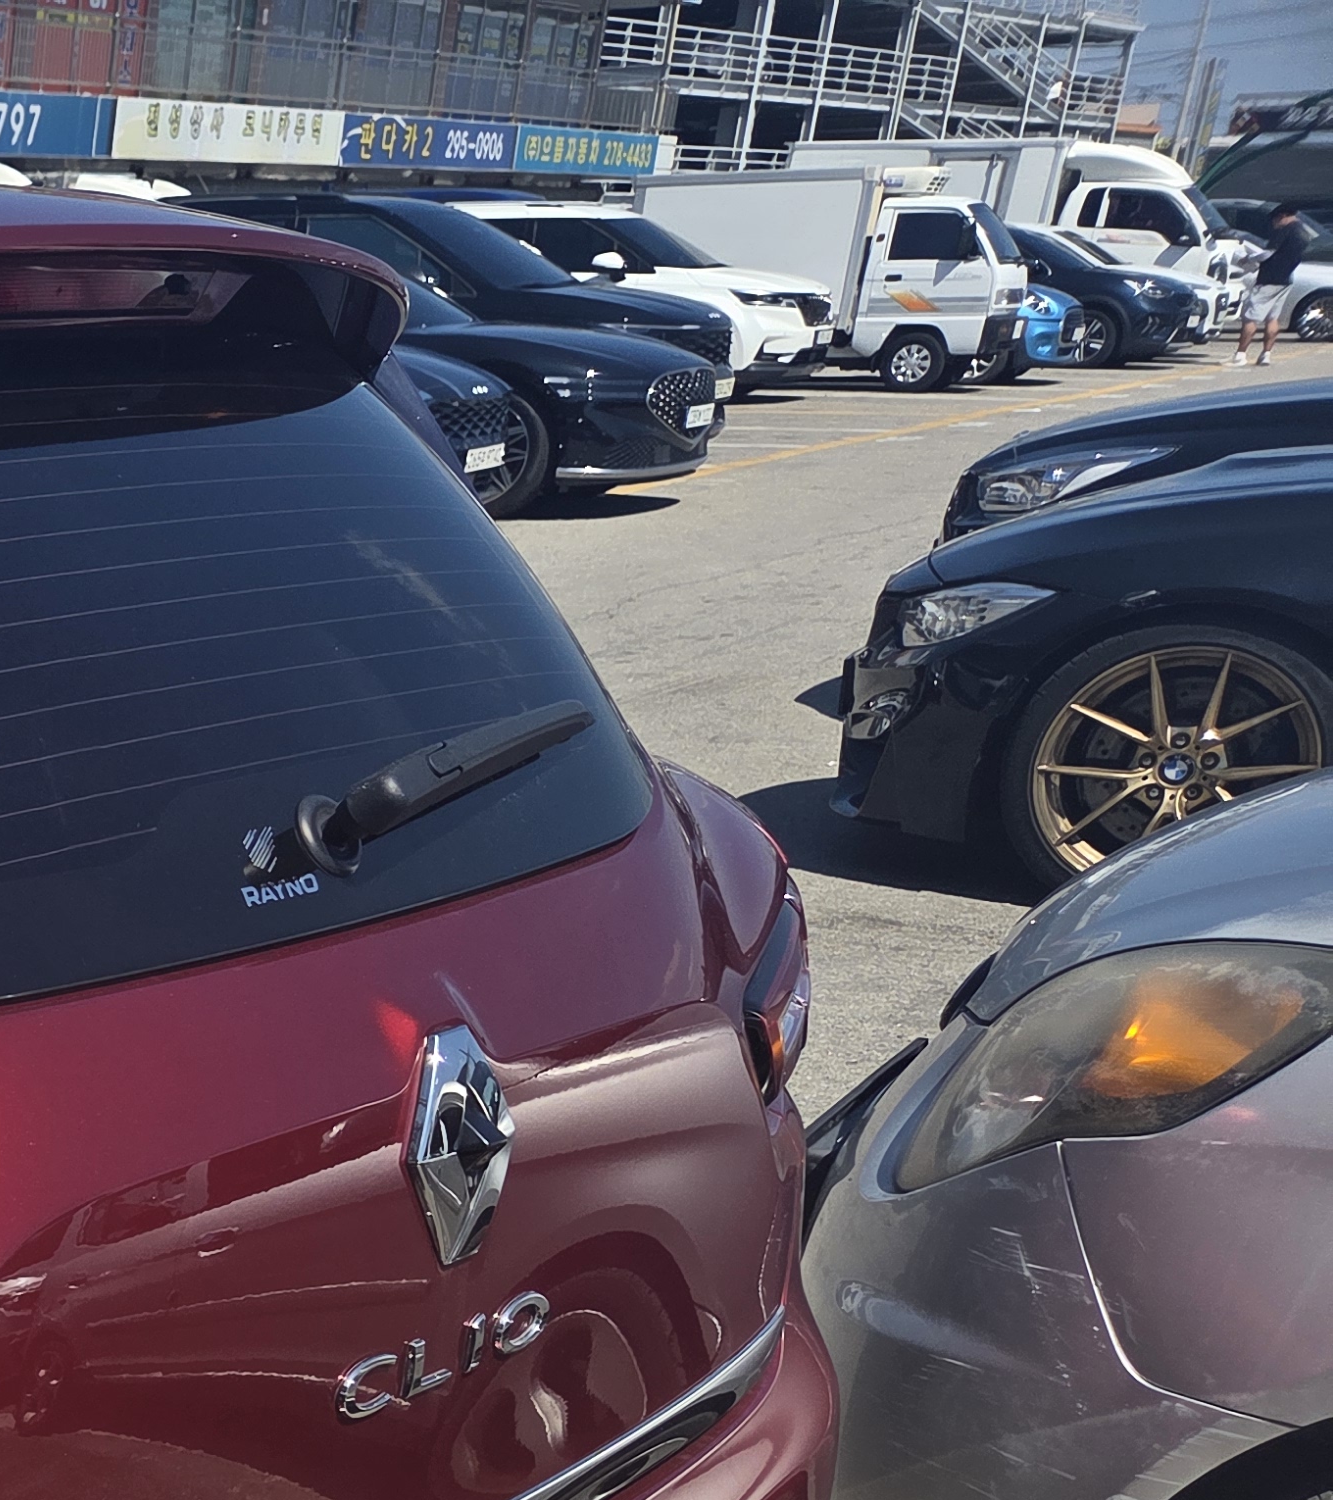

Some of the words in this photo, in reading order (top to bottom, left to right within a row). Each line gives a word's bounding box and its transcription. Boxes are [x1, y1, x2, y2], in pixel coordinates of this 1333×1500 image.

[445, 129, 503, 161] 295-0906
[241, 873, 319, 907] RAYNO
[336, 1291, 550, 1420] CLIO
